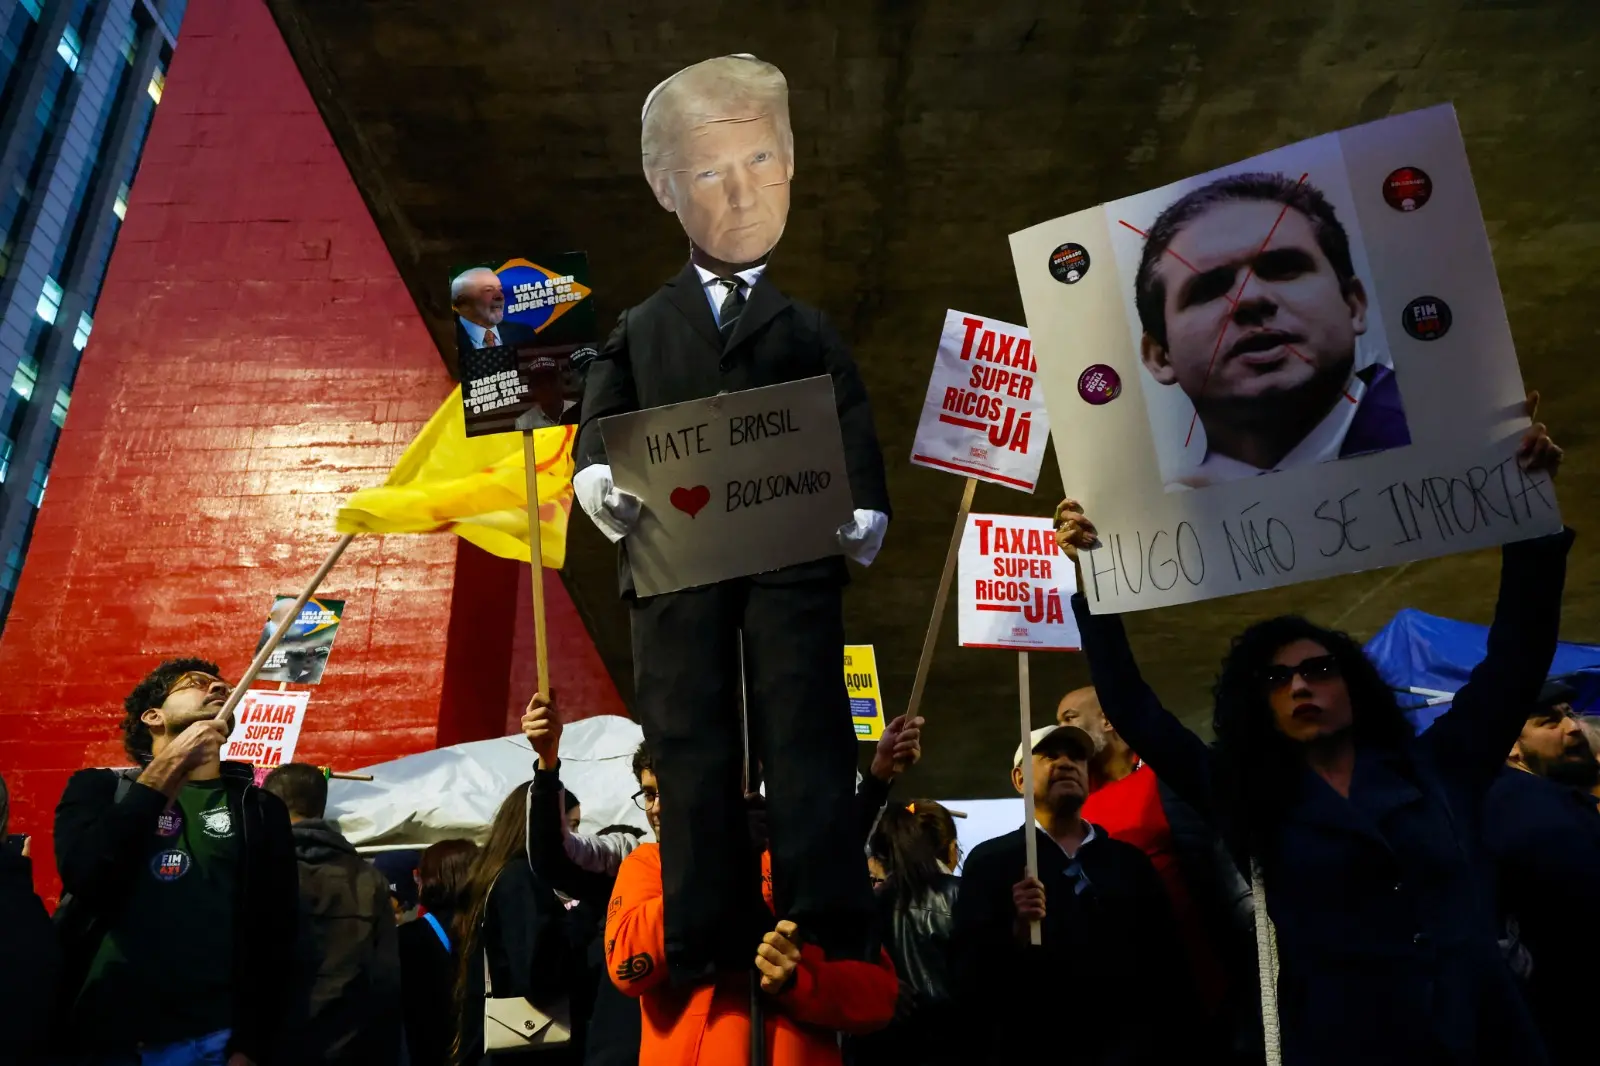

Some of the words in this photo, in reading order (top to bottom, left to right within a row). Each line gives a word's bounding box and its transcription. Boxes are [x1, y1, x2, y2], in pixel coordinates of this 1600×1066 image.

[513, 281, 542, 293] LULA
[545, 275, 574, 287] QUER
[516, 288, 554, 302] TAXAR
[556, 284, 572, 293] OS
[508, 292, 582, 313] SUPER-RICOS
[1413, 303, 1437, 319] FIM
[960, 317, 1038, 373] TAXA
[470, 370, 517, 388] TARCÍSIO
[470, 384, 497, 397] QUER
[499, 378, 520, 389] QUE
[969, 365, 1033, 400] SUPER
[464, 392, 499, 407] TRUMP
[501, 385, 528, 397] TAXE
[473, 405, 480, 414] O
[482, 395, 520, 412] BRASIL
[646, 423, 711, 465] HATE
[729, 409, 799, 446] BRASIL
[988, 407, 1032, 454] JÁ
[726, 471, 831, 512] BOLSONARO
[975, 519, 1059, 556] TAXAR
[1089, 521, 1204, 602] HUGO
[1222, 501, 1296, 581] NÃO
[1313, 488, 1370, 557] SE
[1378, 457, 1553, 546] IMPORTA
[993, 557, 1052, 579] SUPER
[1024, 587, 1064, 624] JÁ
[847, 673, 872, 691] AQUI
[240, 698, 296, 724] TAXAR
[245, 725, 284, 741] SUPER
[255, 747, 282, 765] JÁ
[162, 854, 182, 863] FIM
